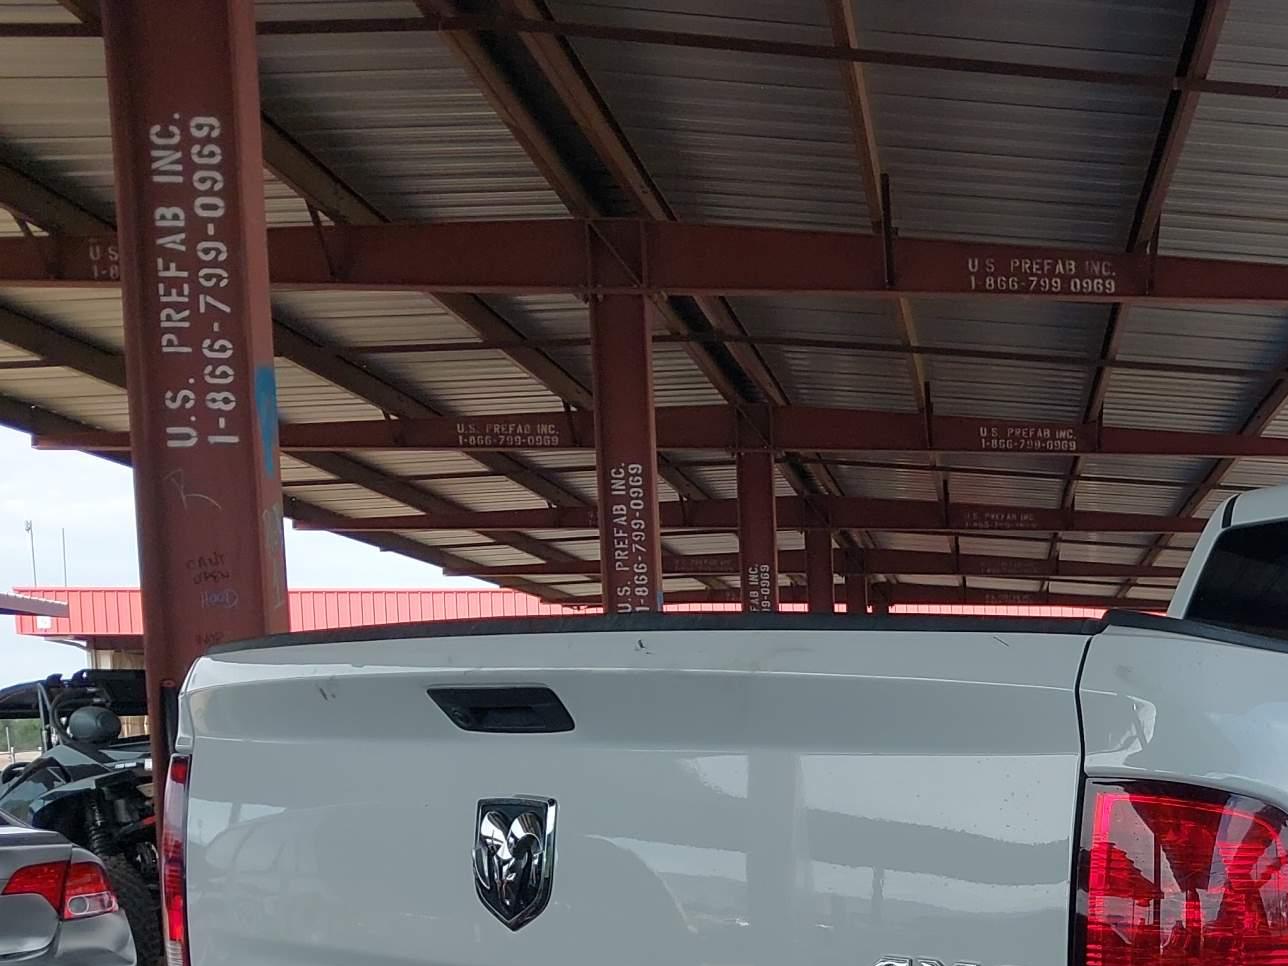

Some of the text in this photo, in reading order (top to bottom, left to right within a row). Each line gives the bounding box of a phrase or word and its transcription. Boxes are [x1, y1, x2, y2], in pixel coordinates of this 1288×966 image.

[149, 112, 198, 448] U.S. PREFAB INC.
[189, 116, 240, 444] 1-866-799-0969
[1010, 258, 1076, 275] PREFAB
[1085, 260, 1116, 277] INC.
[536, 423, 560, 435] INC.
[610, 462, 632, 613] U.S. PREFAB INC.
[628, 463, 650, 613] 1-866-799-0969
